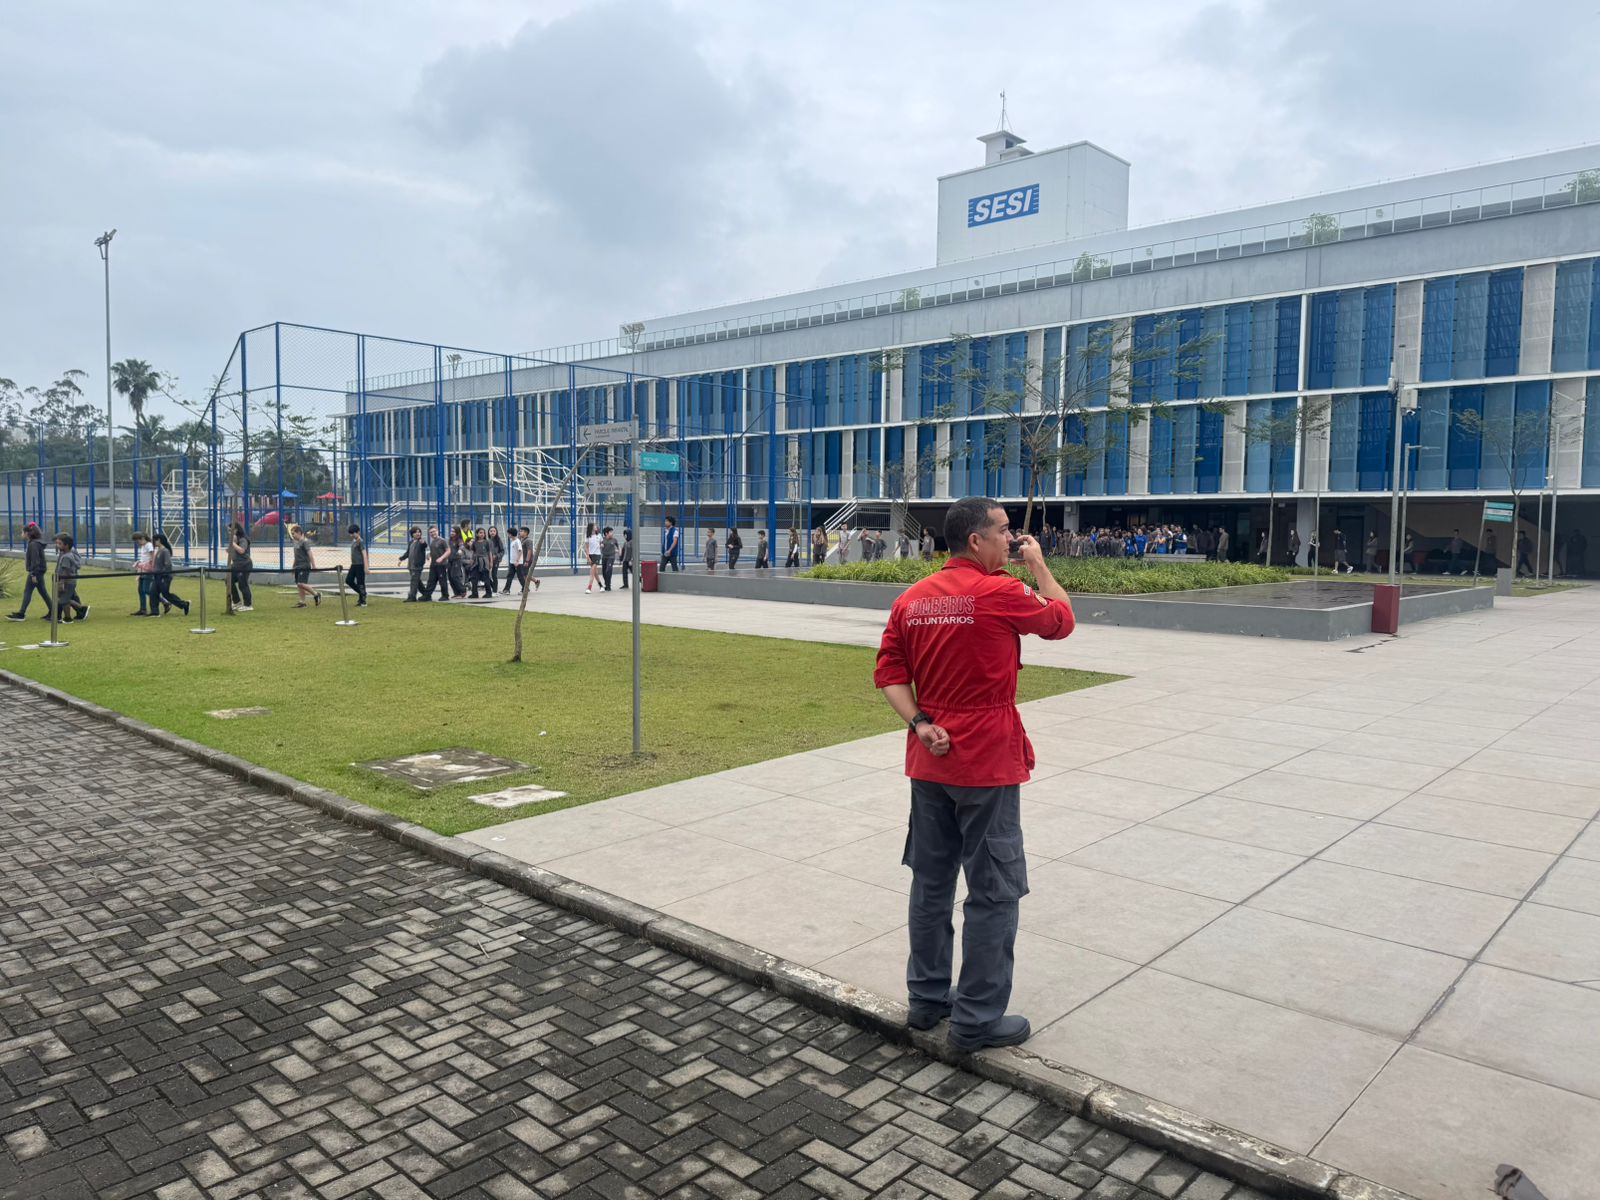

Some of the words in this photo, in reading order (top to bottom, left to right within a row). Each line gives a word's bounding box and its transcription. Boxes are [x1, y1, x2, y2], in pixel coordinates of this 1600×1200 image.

[973, 188, 1033, 222] SESI
[905, 595, 976, 618] BOMBEIROS
[906, 615, 975, 627] VOLUNTÁRIOS
